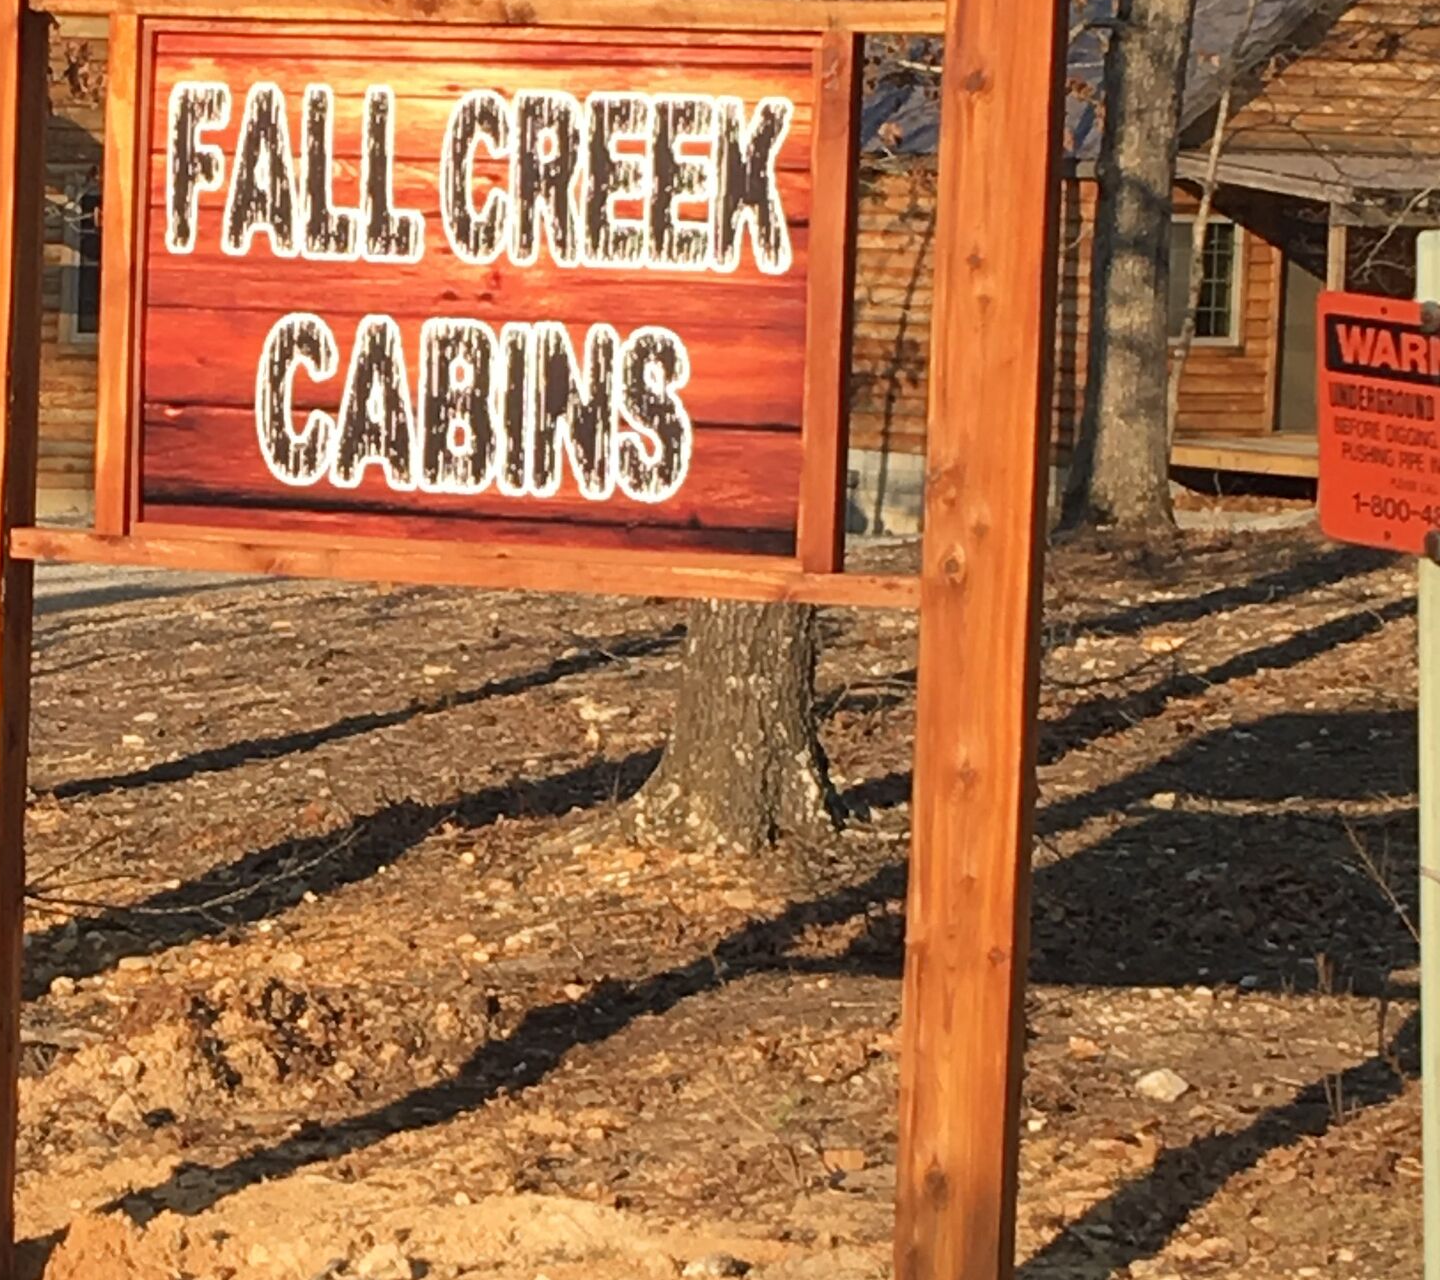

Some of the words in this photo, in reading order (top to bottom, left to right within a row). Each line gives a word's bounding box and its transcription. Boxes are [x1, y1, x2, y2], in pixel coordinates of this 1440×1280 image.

[166, 81, 425, 264] FALL
[441, 88, 794, 275] CREEK
[256, 312, 692, 503] CABINS
